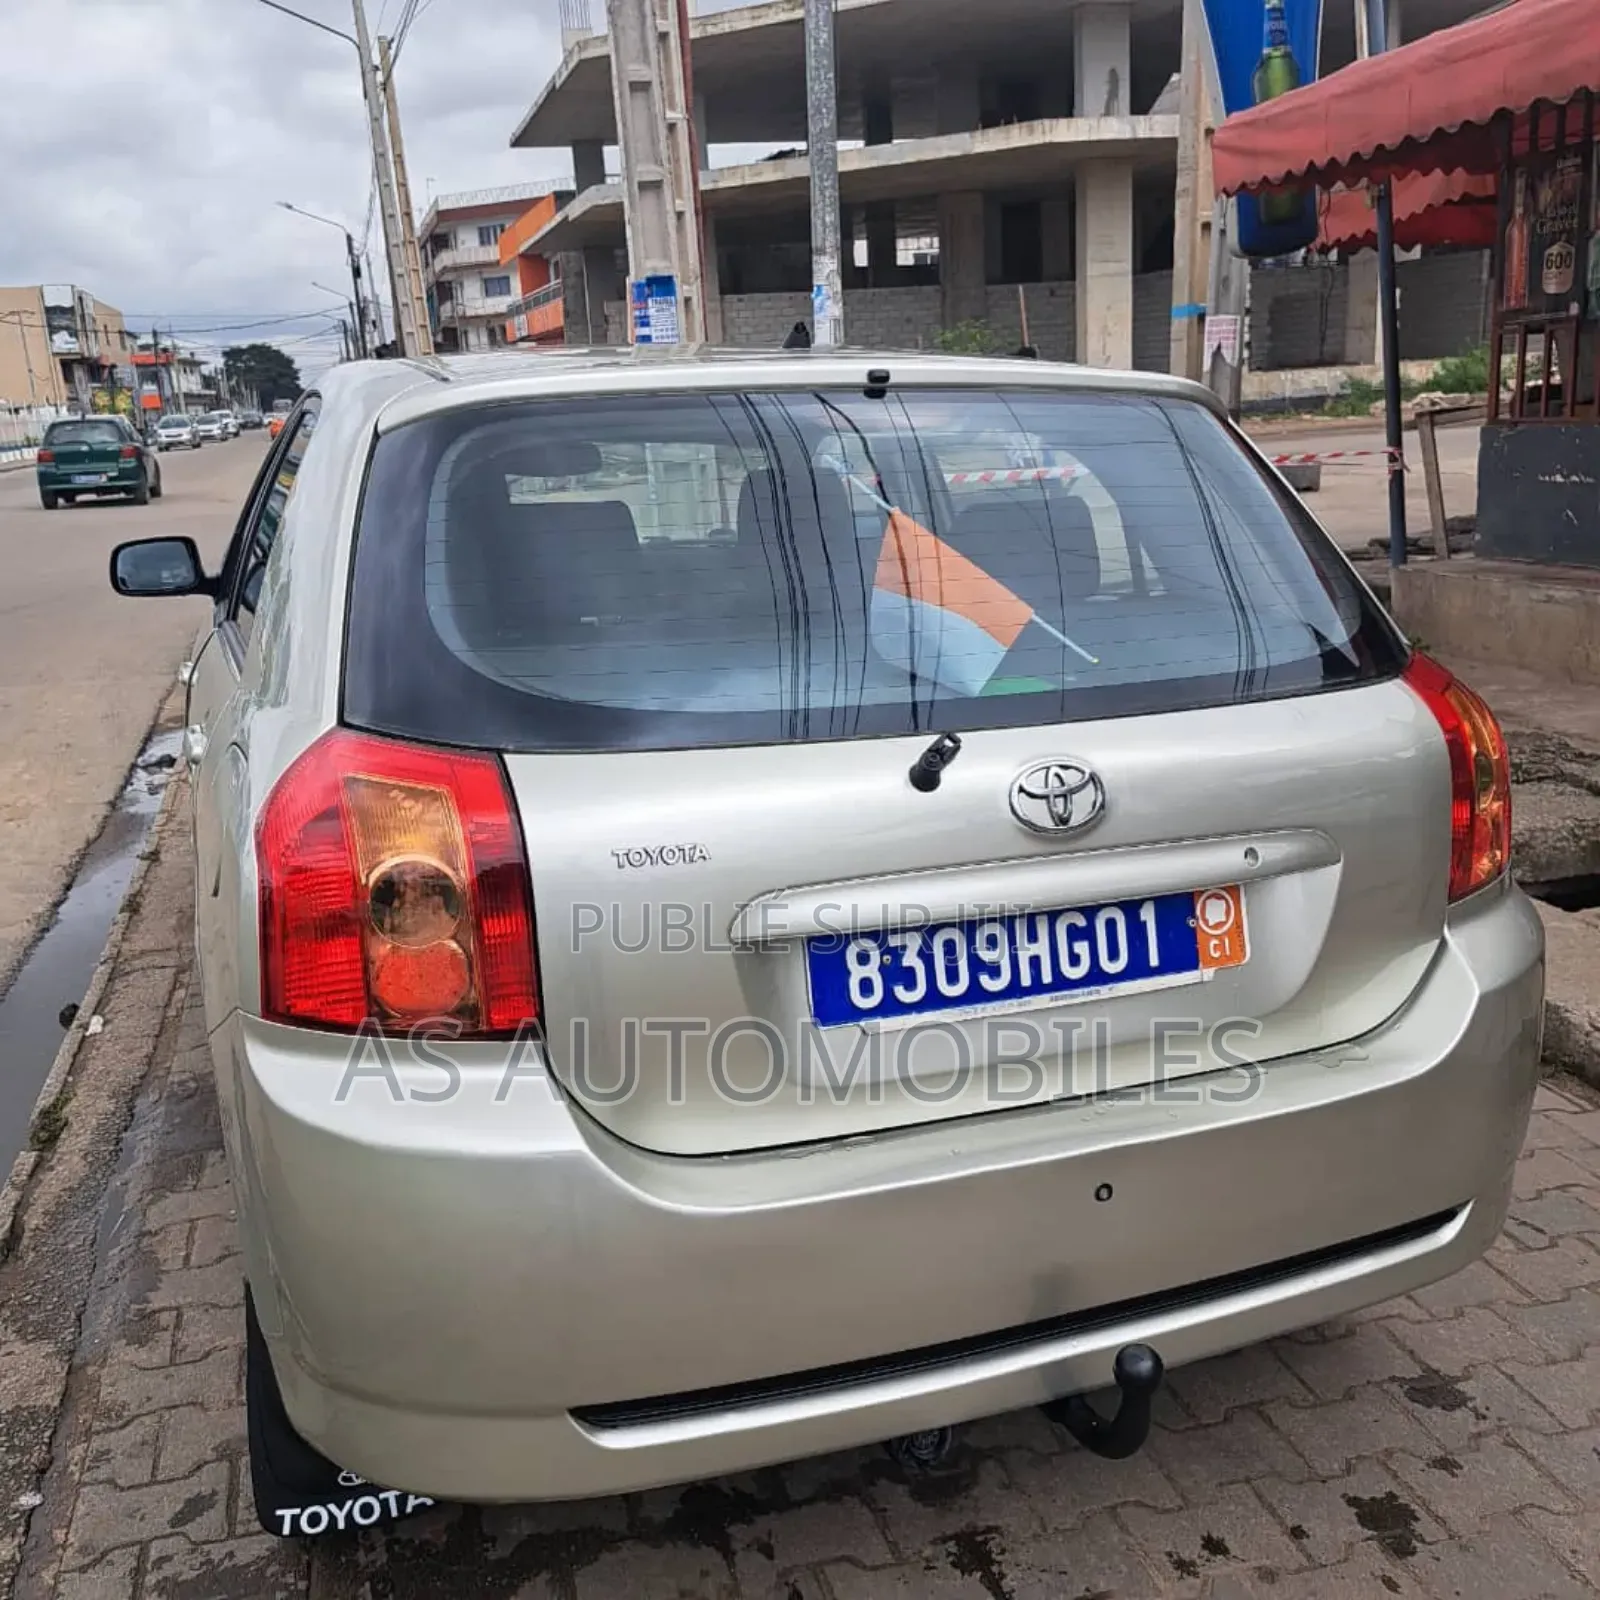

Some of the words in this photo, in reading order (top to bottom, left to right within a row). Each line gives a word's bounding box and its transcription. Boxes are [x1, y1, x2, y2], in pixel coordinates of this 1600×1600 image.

[1545, 252, 1573, 269] 600
[611, 844, 712, 869] TOYOTA
[846, 900, 1160, 1010] 8309HG01
[1209, 937, 1230, 958] CI
